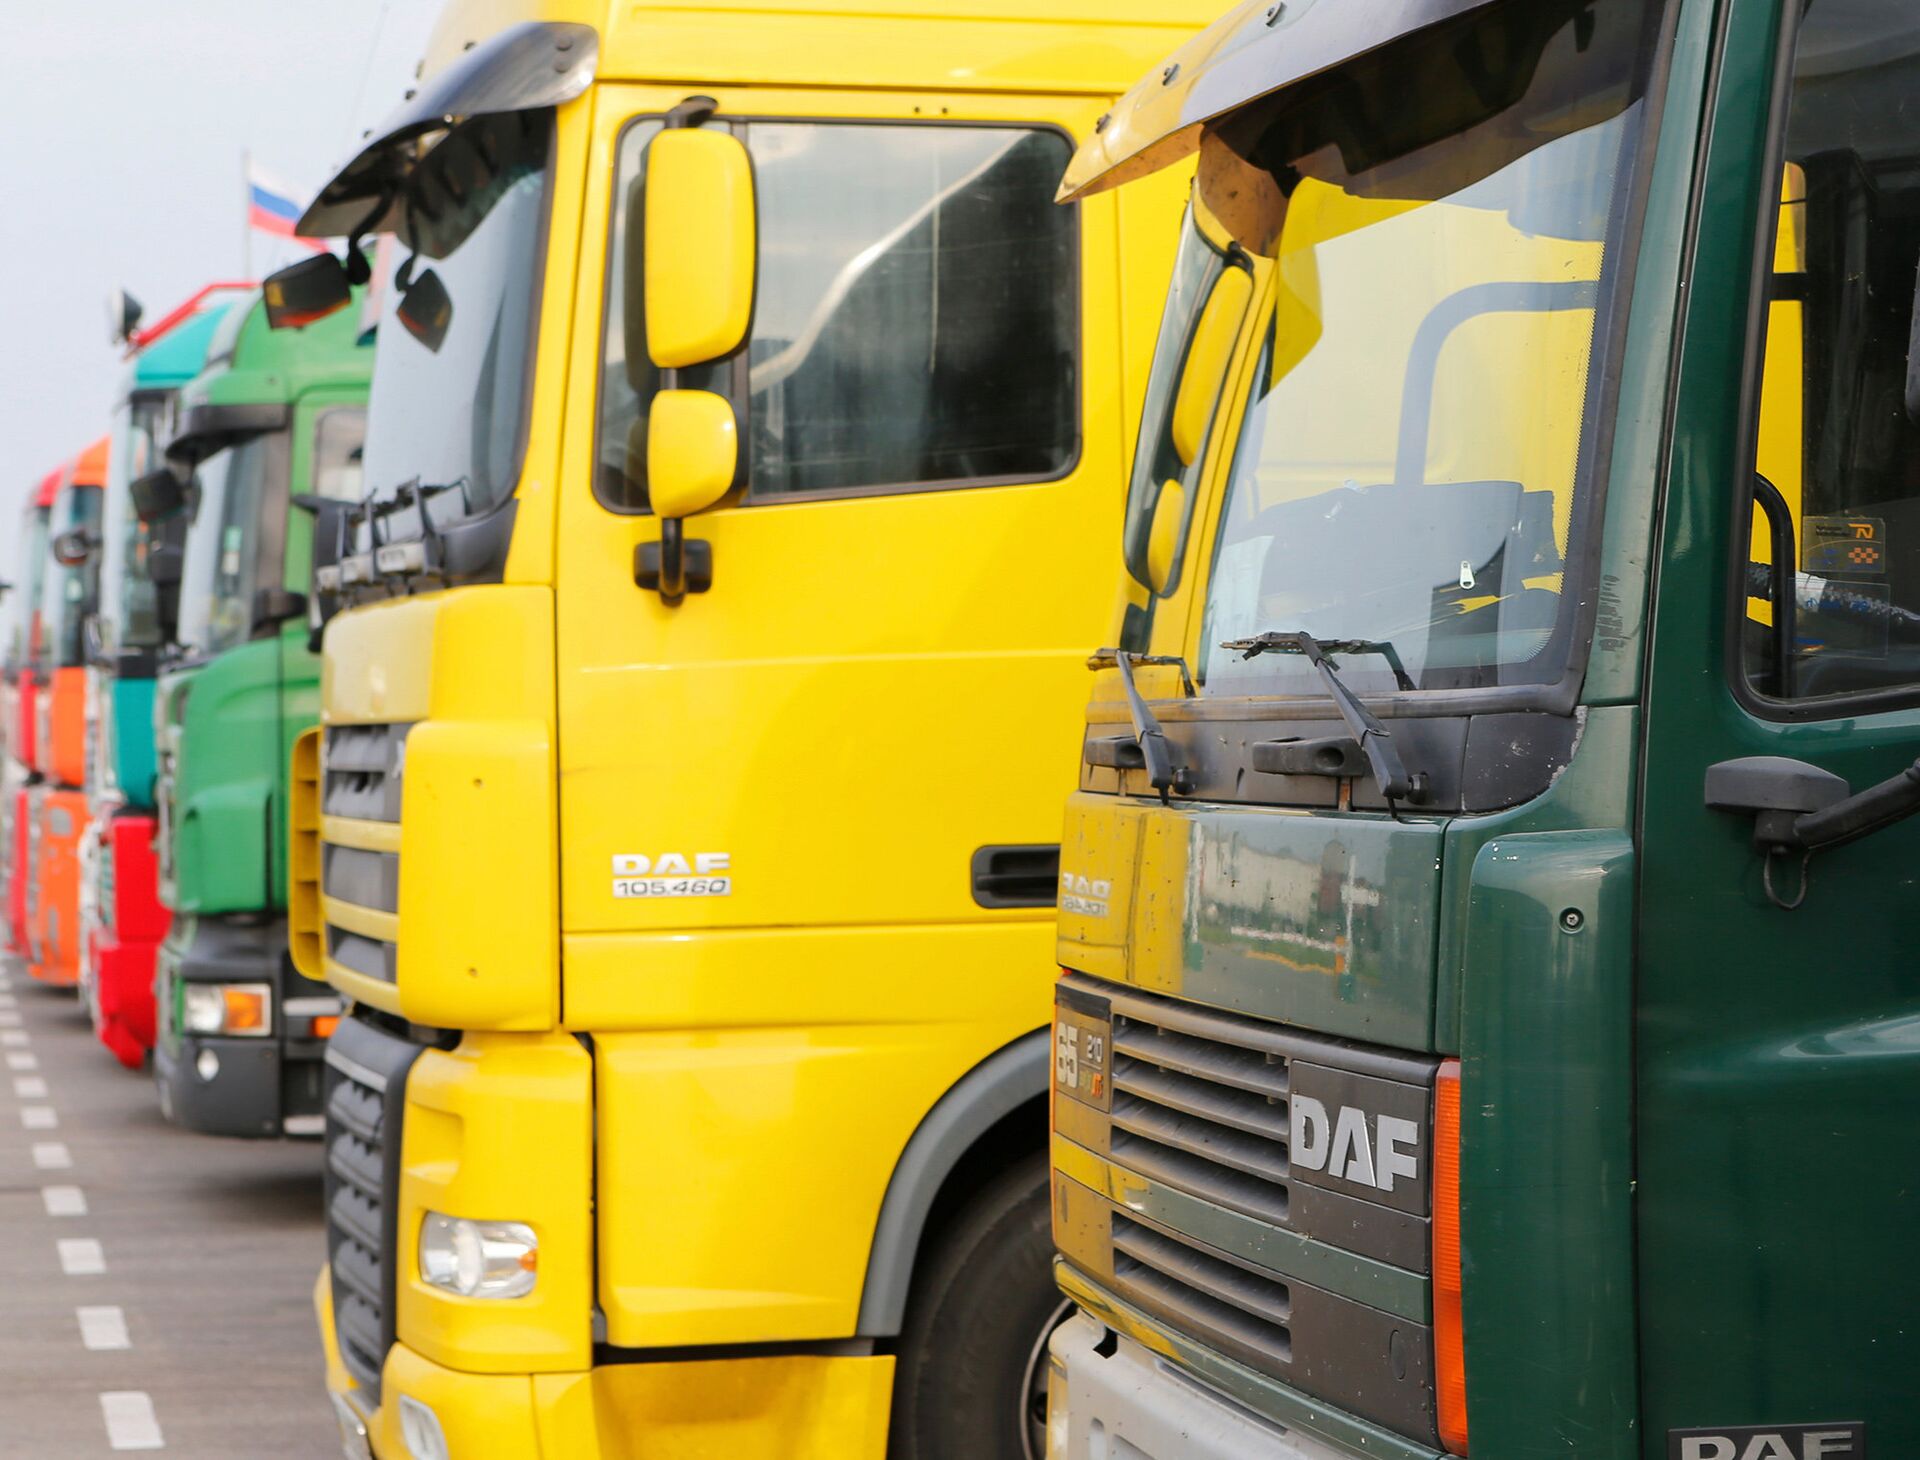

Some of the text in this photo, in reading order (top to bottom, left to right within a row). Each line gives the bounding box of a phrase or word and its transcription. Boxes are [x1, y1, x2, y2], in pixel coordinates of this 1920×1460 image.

[612, 852, 730, 876] DAF
[617, 879, 727, 897] 105.460
[1291, 1094, 1418, 1192] DAF
[1681, 1431, 1852, 1460] DAF
